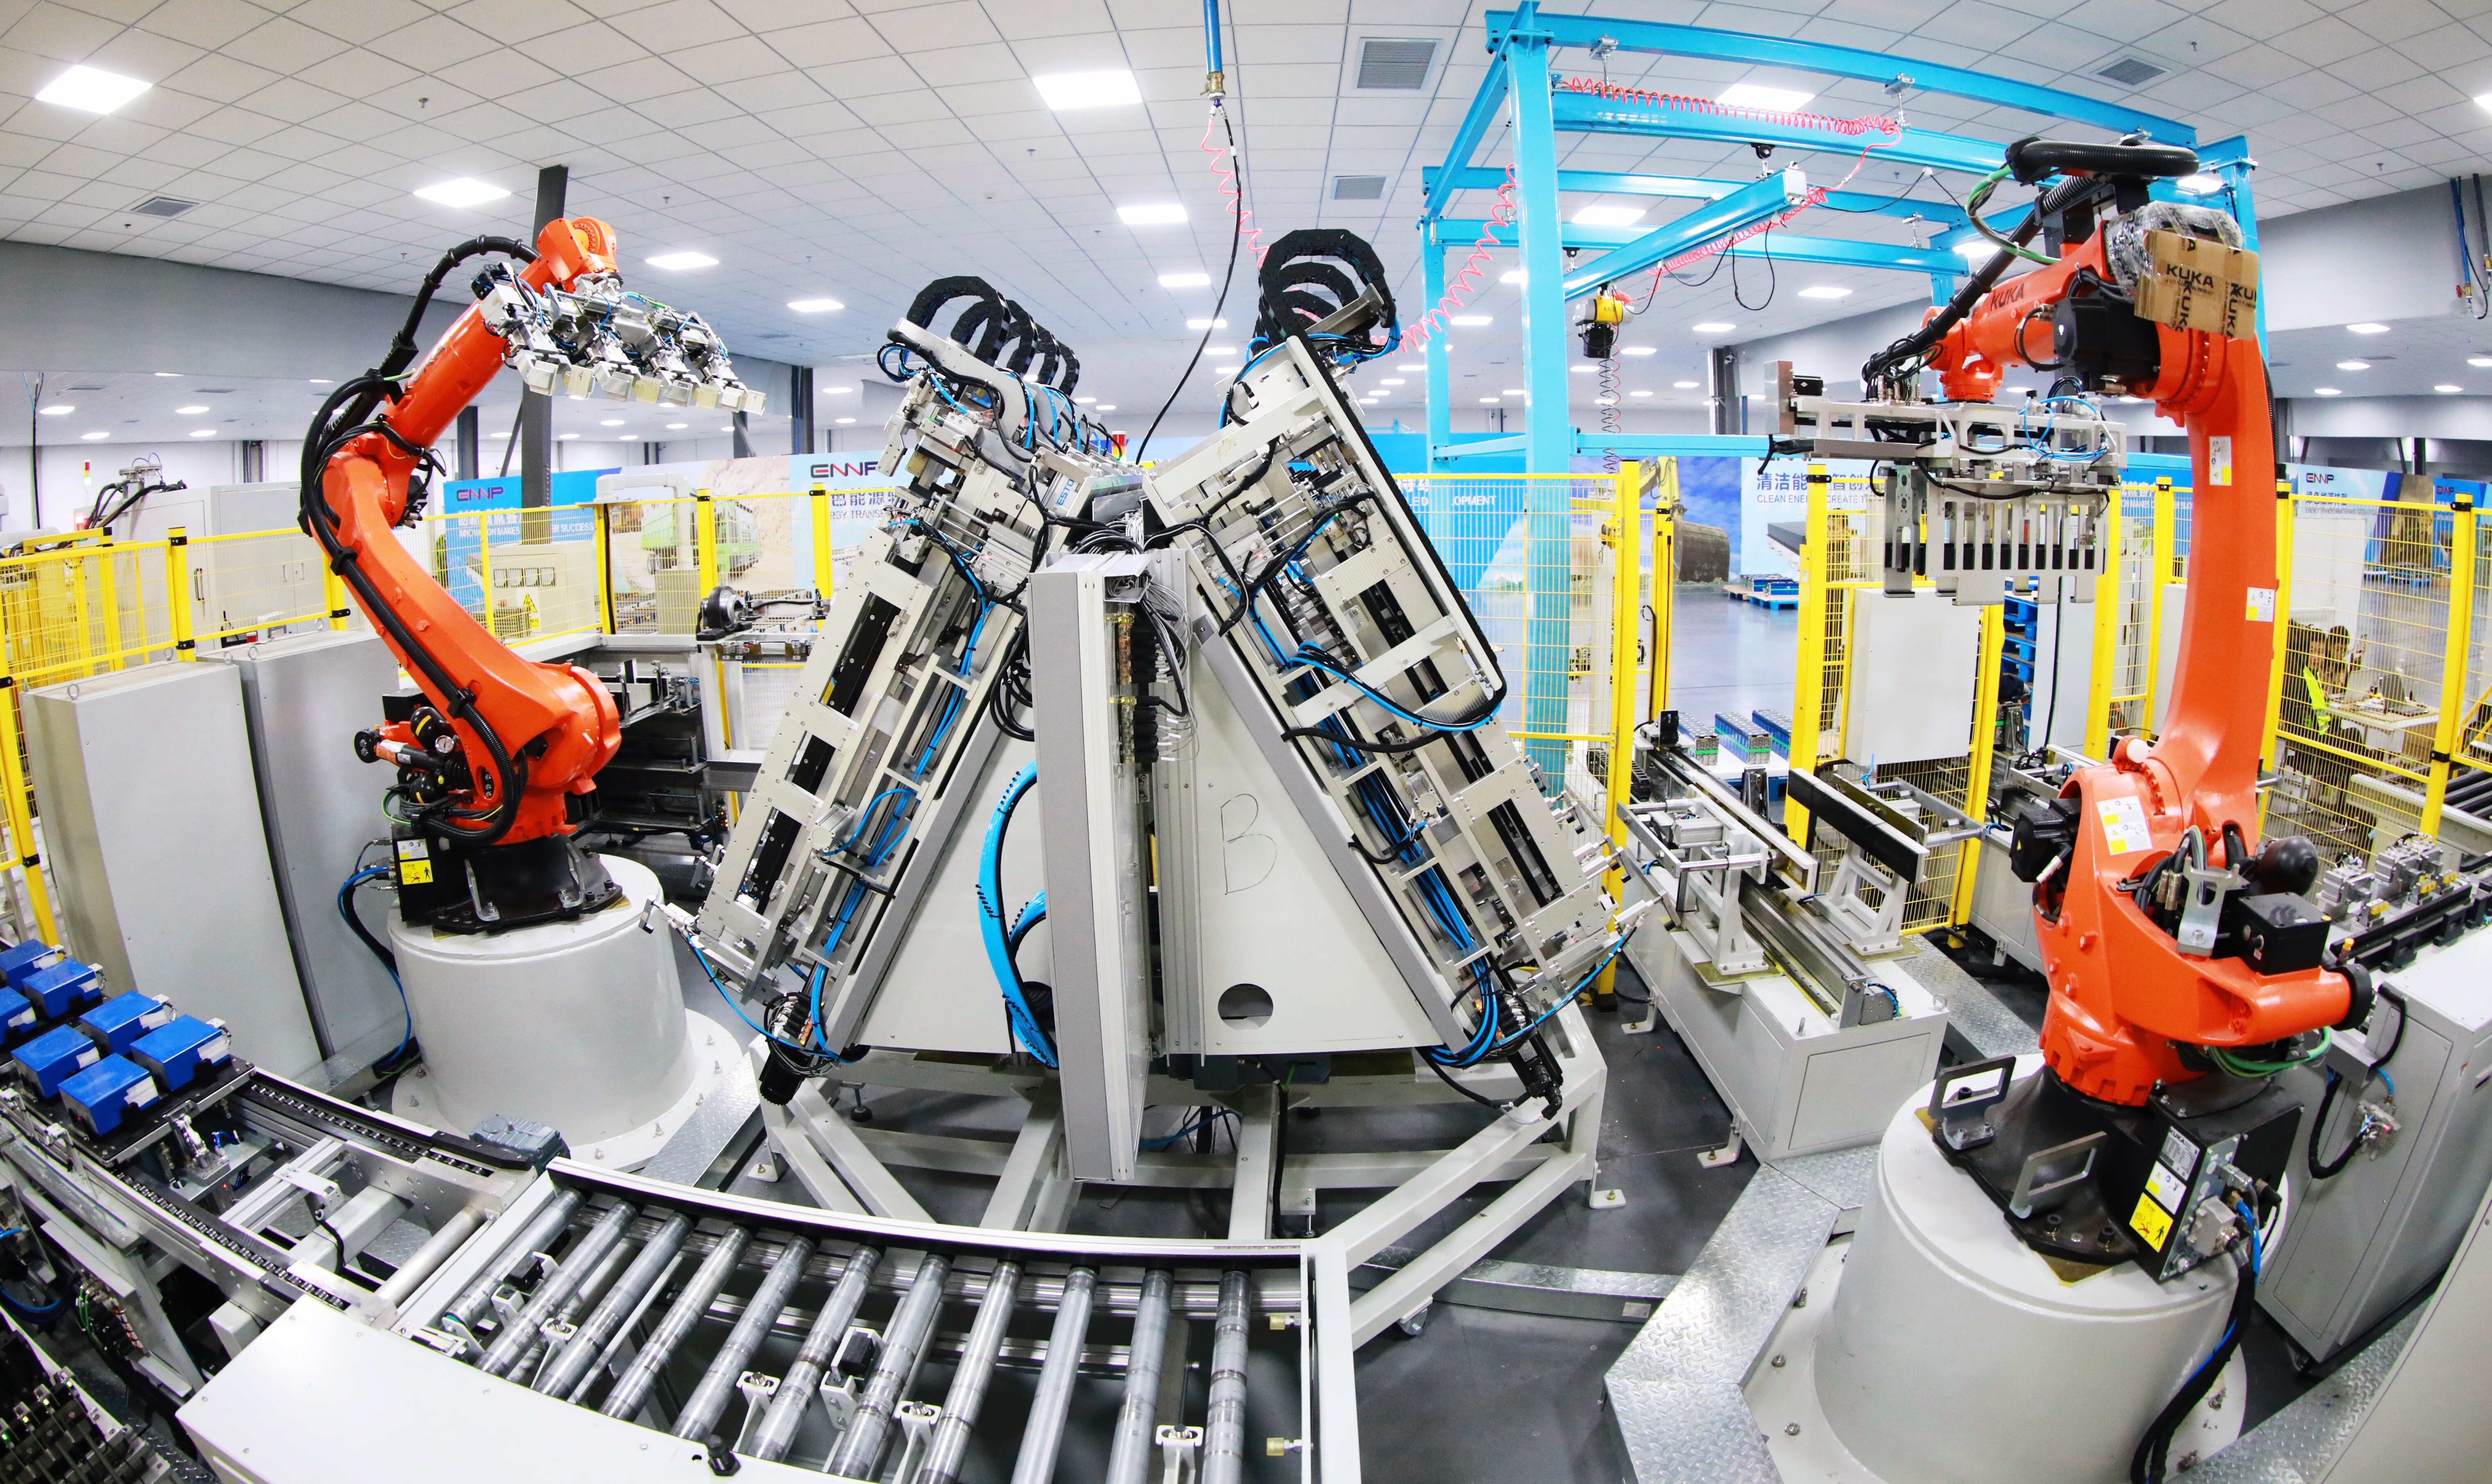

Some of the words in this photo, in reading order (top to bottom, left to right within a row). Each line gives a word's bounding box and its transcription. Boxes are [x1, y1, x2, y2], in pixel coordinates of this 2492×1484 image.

[2166, 264, 2213, 288] KUKA
[1990, 283, 2024, 311] KUKA
[2234, 286, 2256, 302] KU
[1056, 479, 1074, 506] ESTO
[1757, 495, 1786, 503] CLEAN
[1827, 495, 1860, 503] CREATE
[459, 527, 497, 538] INNOVAON
[499, 526, 520, 536] MAKES
[561, 522, 595, 532] SUCCESS
[1220, 793, 1277, 895] B
